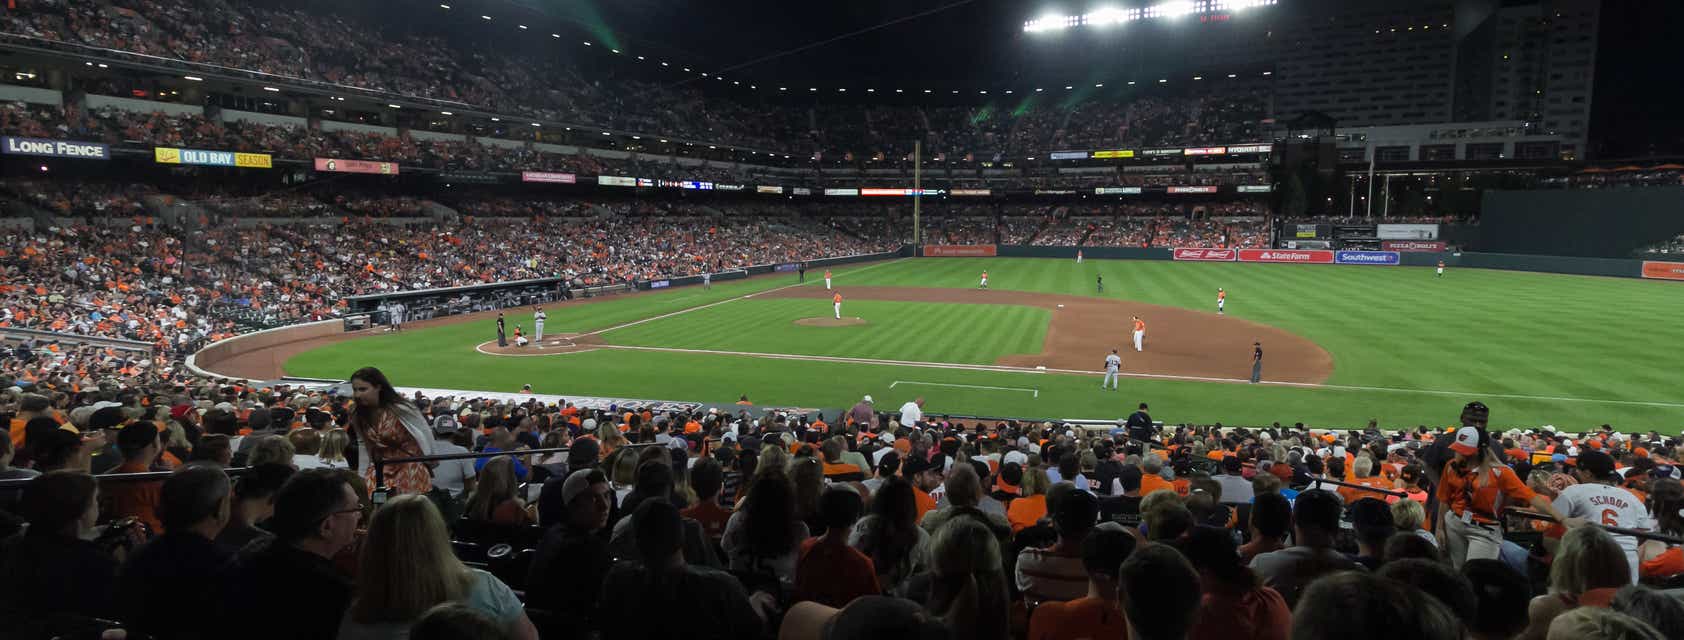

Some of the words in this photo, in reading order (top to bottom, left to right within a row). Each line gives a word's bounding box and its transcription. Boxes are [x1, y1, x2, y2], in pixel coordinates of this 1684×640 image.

[9, 138, 53, 154] LONG
[56, 142, 104, 157] FENCE
[183, 151, 207, 163] OLD
[210, 152, 232, 164] BAY
[238, 154, 269, 167] SEASON
[1271, 252, 1290, 260] State
[1291, 252, 1310, 260] Farm
[1343, 253, 1386, 261] Southwest
[1590, 496, 1629, 510] SCHOOP
[1602, 508, 1618, 527] 6
